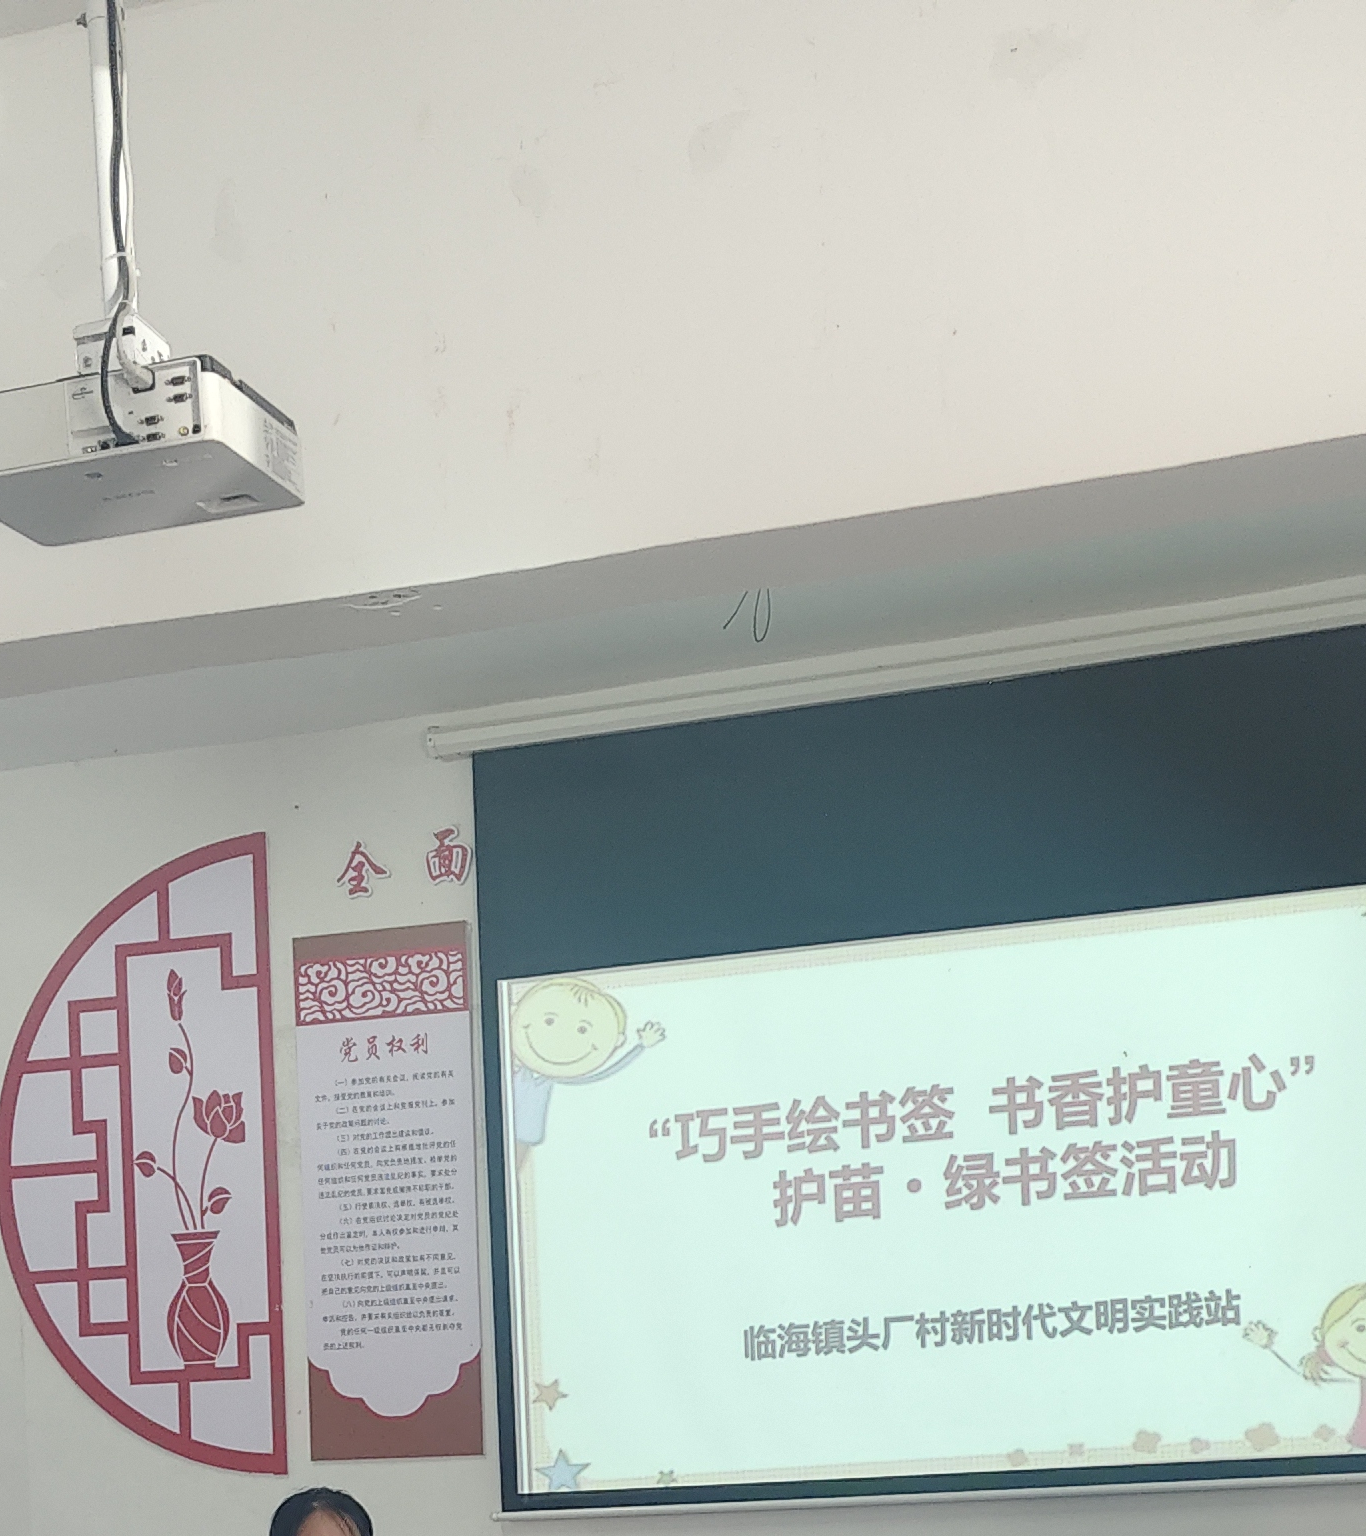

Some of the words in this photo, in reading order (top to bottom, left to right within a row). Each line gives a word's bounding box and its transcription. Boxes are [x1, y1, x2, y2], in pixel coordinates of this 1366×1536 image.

[339, 1032, 429, 1063] 党员权利
[648, 1084, 956, 1163] “巧手绘书签
[989, 1053, 1315, 1136] 书香护童心”
[743, 1288, 1242, 1361] 临海镇头厂村新时代文明实践站
